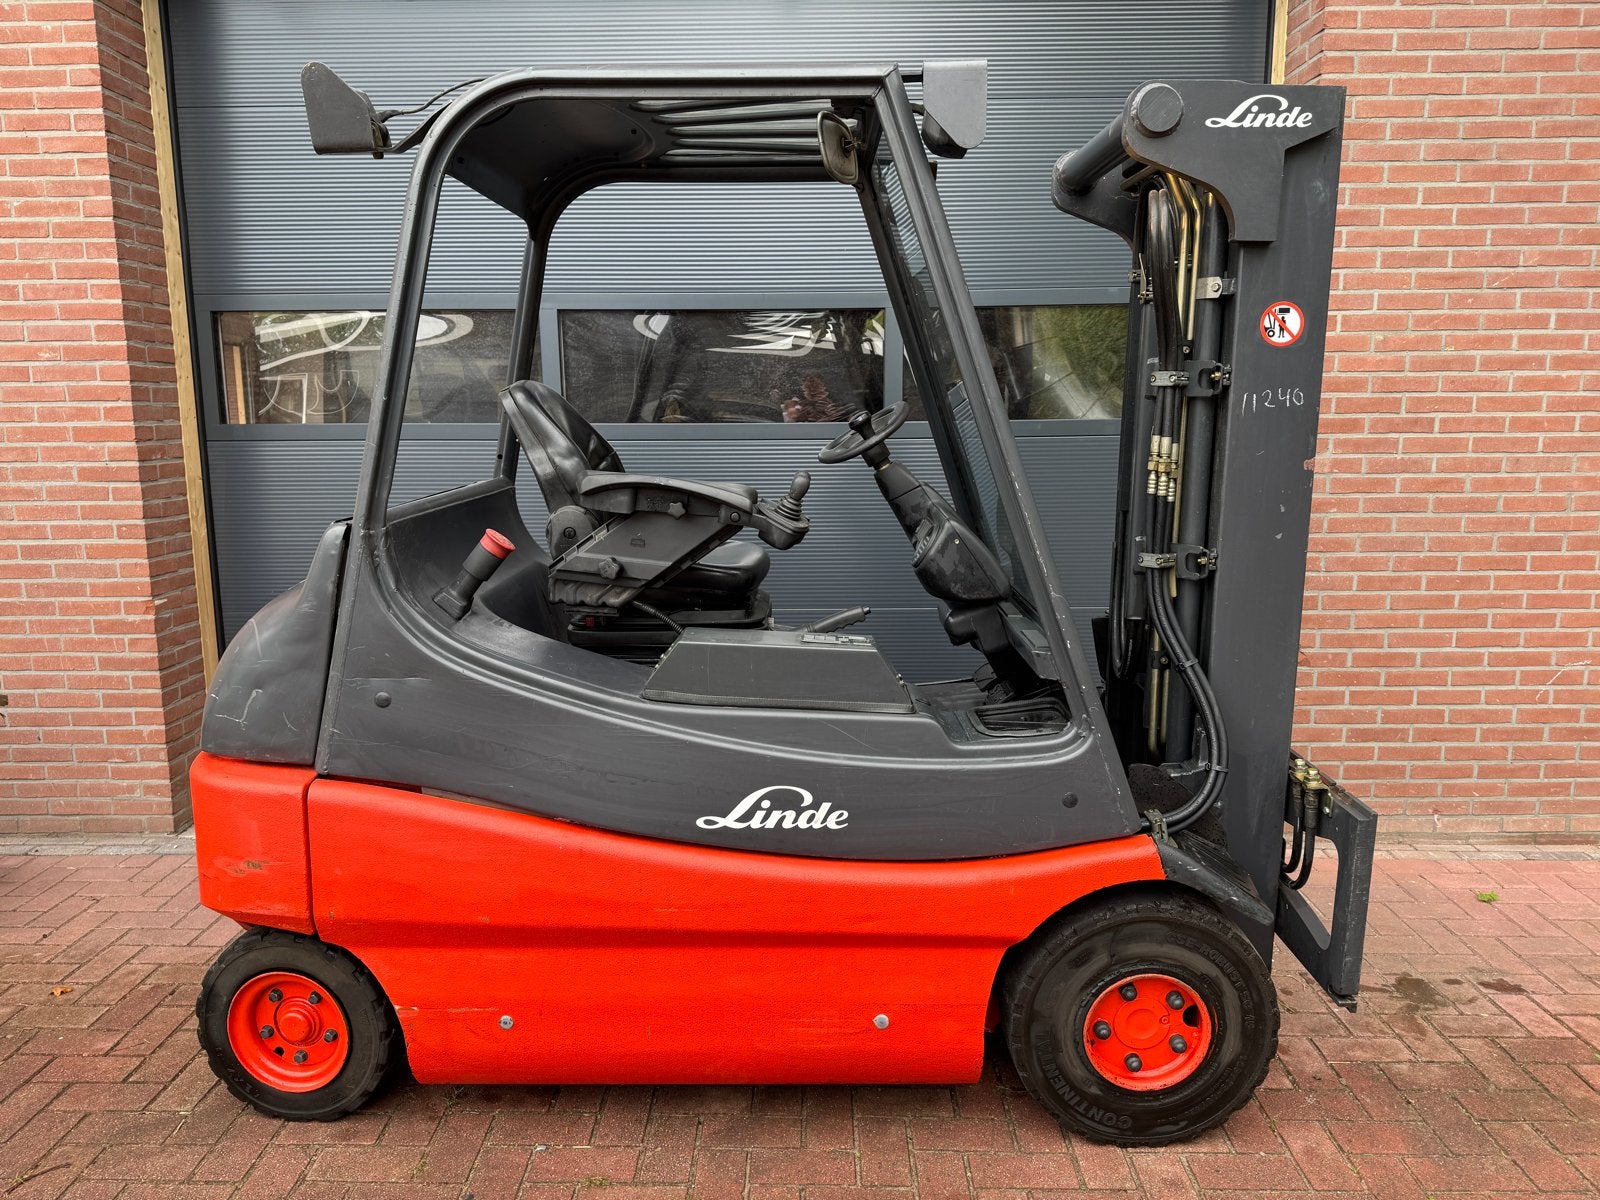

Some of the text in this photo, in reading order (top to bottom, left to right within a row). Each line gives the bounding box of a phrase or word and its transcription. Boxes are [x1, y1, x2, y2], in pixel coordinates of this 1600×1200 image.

[1205, 94, 1313, 128] Linde
[1241, 388, 1304, 416] 11240
[696, 785, 849, 830] Linde
